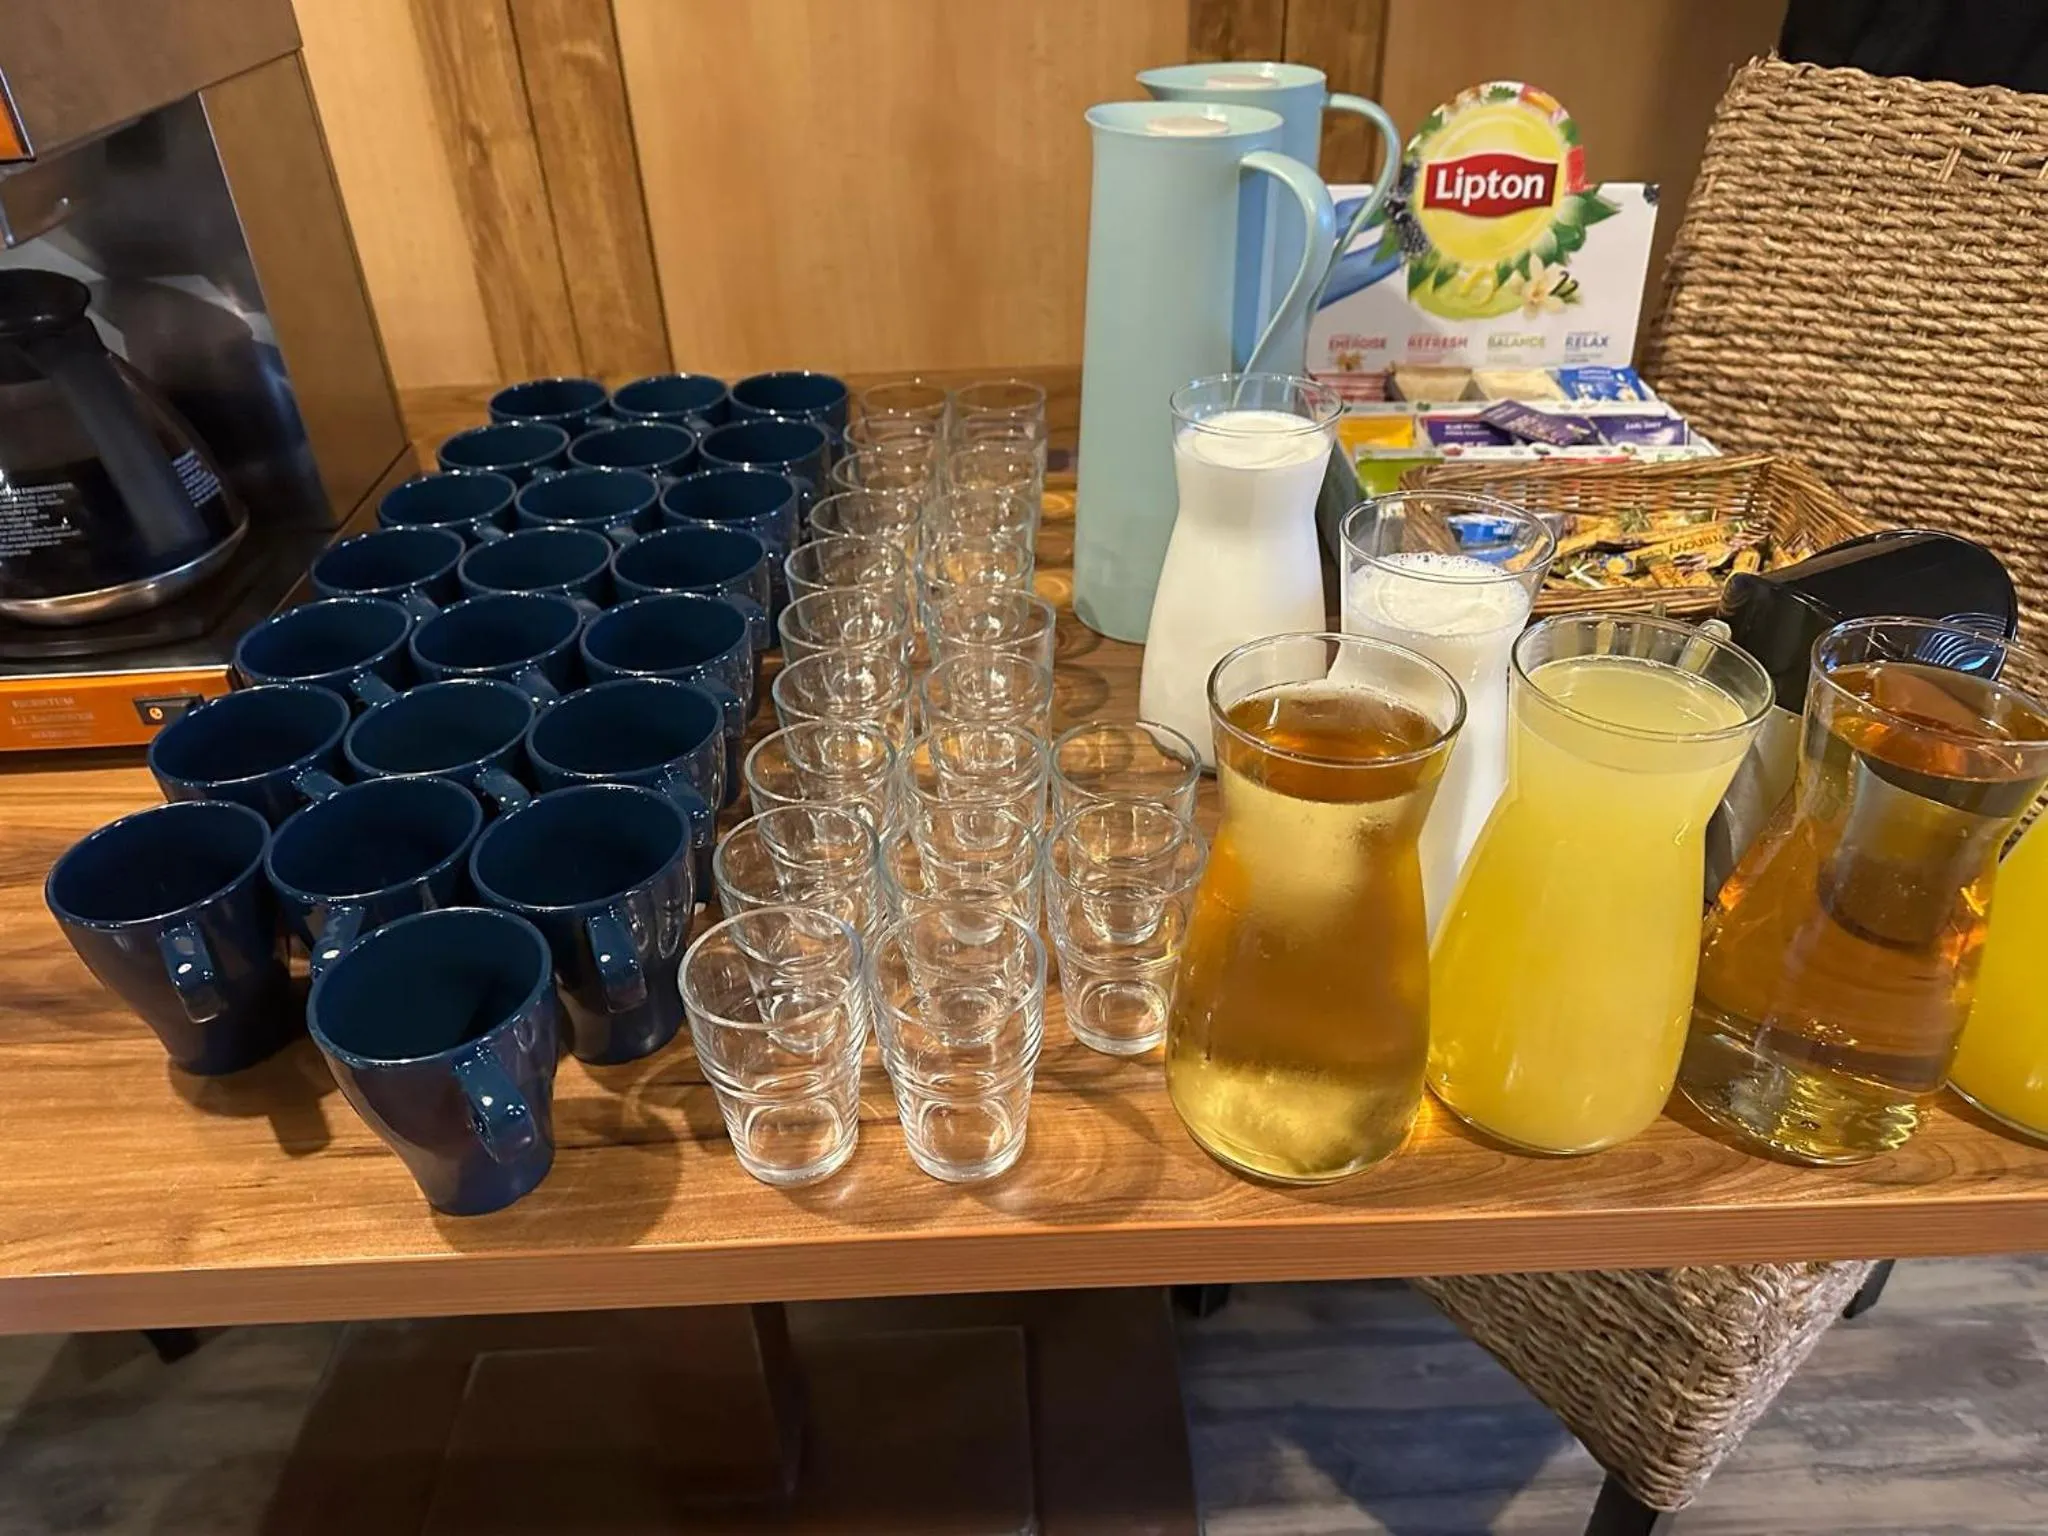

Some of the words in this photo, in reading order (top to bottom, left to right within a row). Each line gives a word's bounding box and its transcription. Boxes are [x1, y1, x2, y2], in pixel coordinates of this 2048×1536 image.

[1436, 166, 1545, 207] Lipton
[1407, 335, 1468, 349] REFRESH
[1487, 335, 1546, 348] BALANCE
[1565, 336, 1610, 348] RELAX
